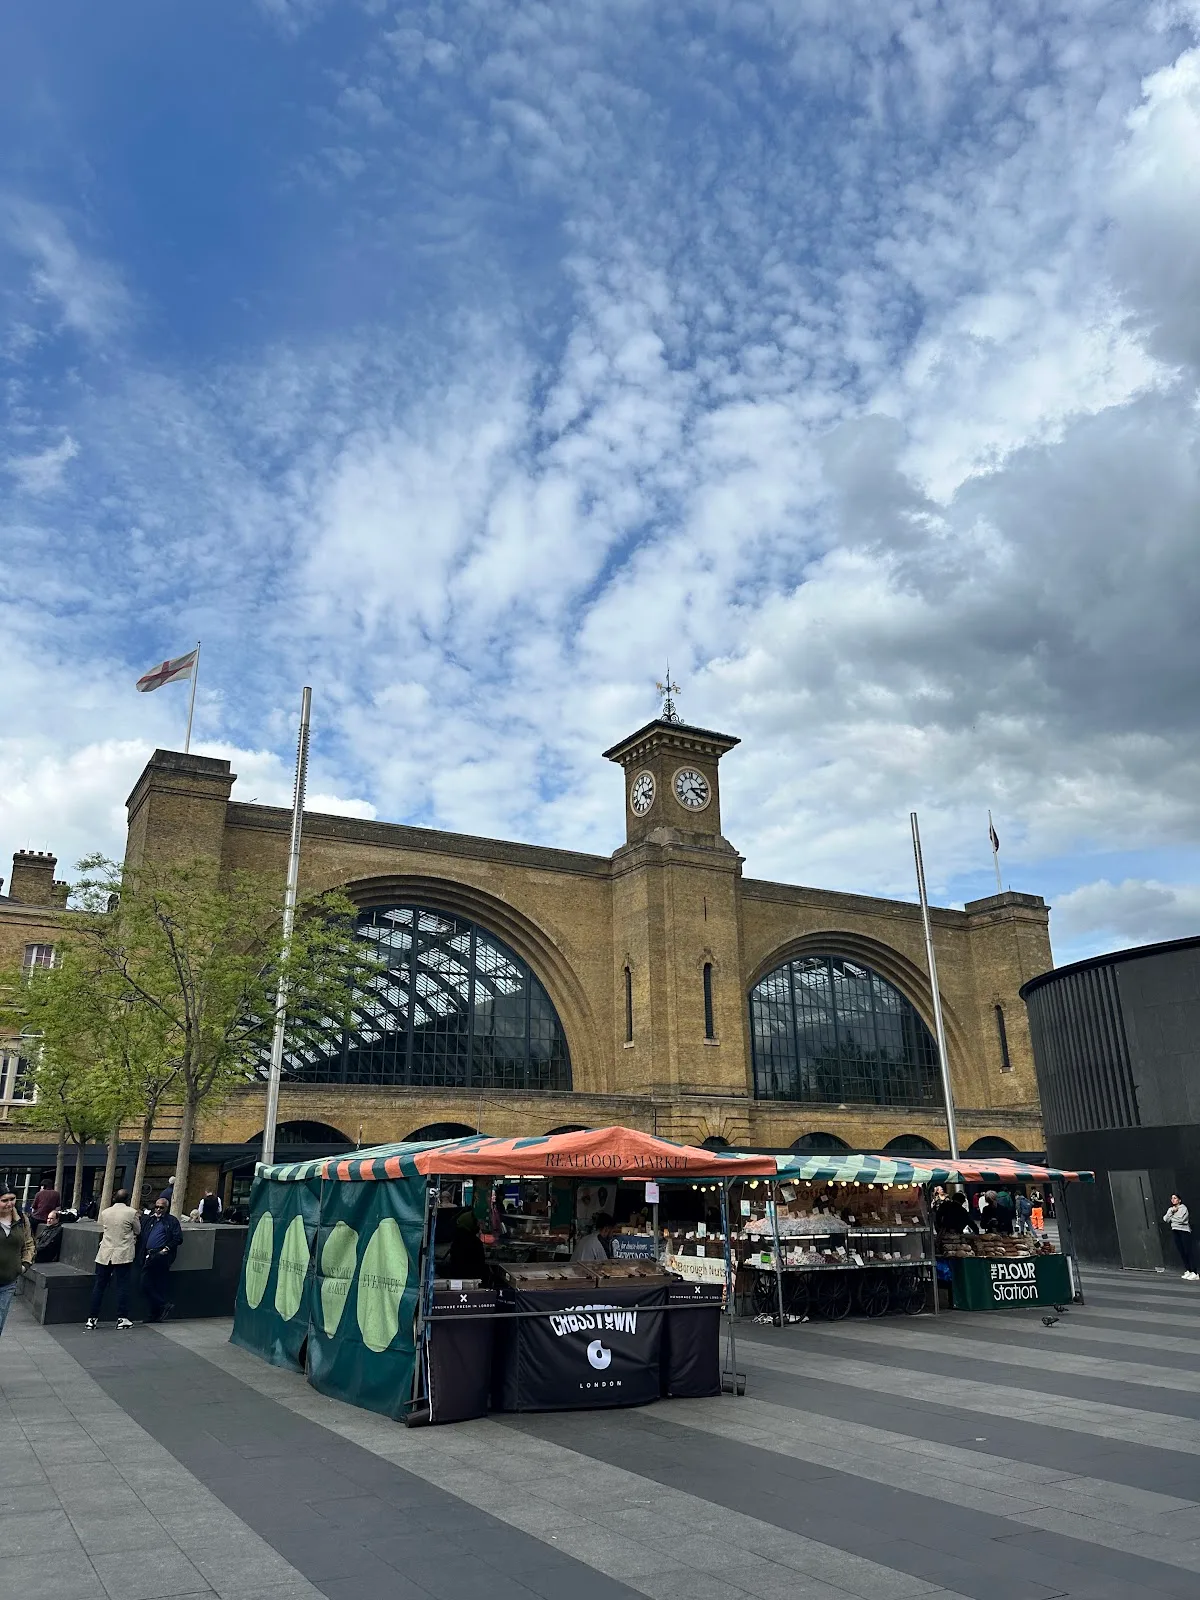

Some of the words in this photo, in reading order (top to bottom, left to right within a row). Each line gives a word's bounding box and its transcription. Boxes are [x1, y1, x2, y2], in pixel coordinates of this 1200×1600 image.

[633, 1154, 689, 1169] MARKET
[677, 1262, 708, 1278] Borough
[709, 1265, 726, 1278] Nuts
[990, 1263, 998, 1280] THE
[997, 1262, 1036, 1280] FLOUR
[992, 1280, 1039, 1301] Station
[549, 1304, 637, 1337] CROSSTOWN
[579, 1381, 622, 1389] LONDON
